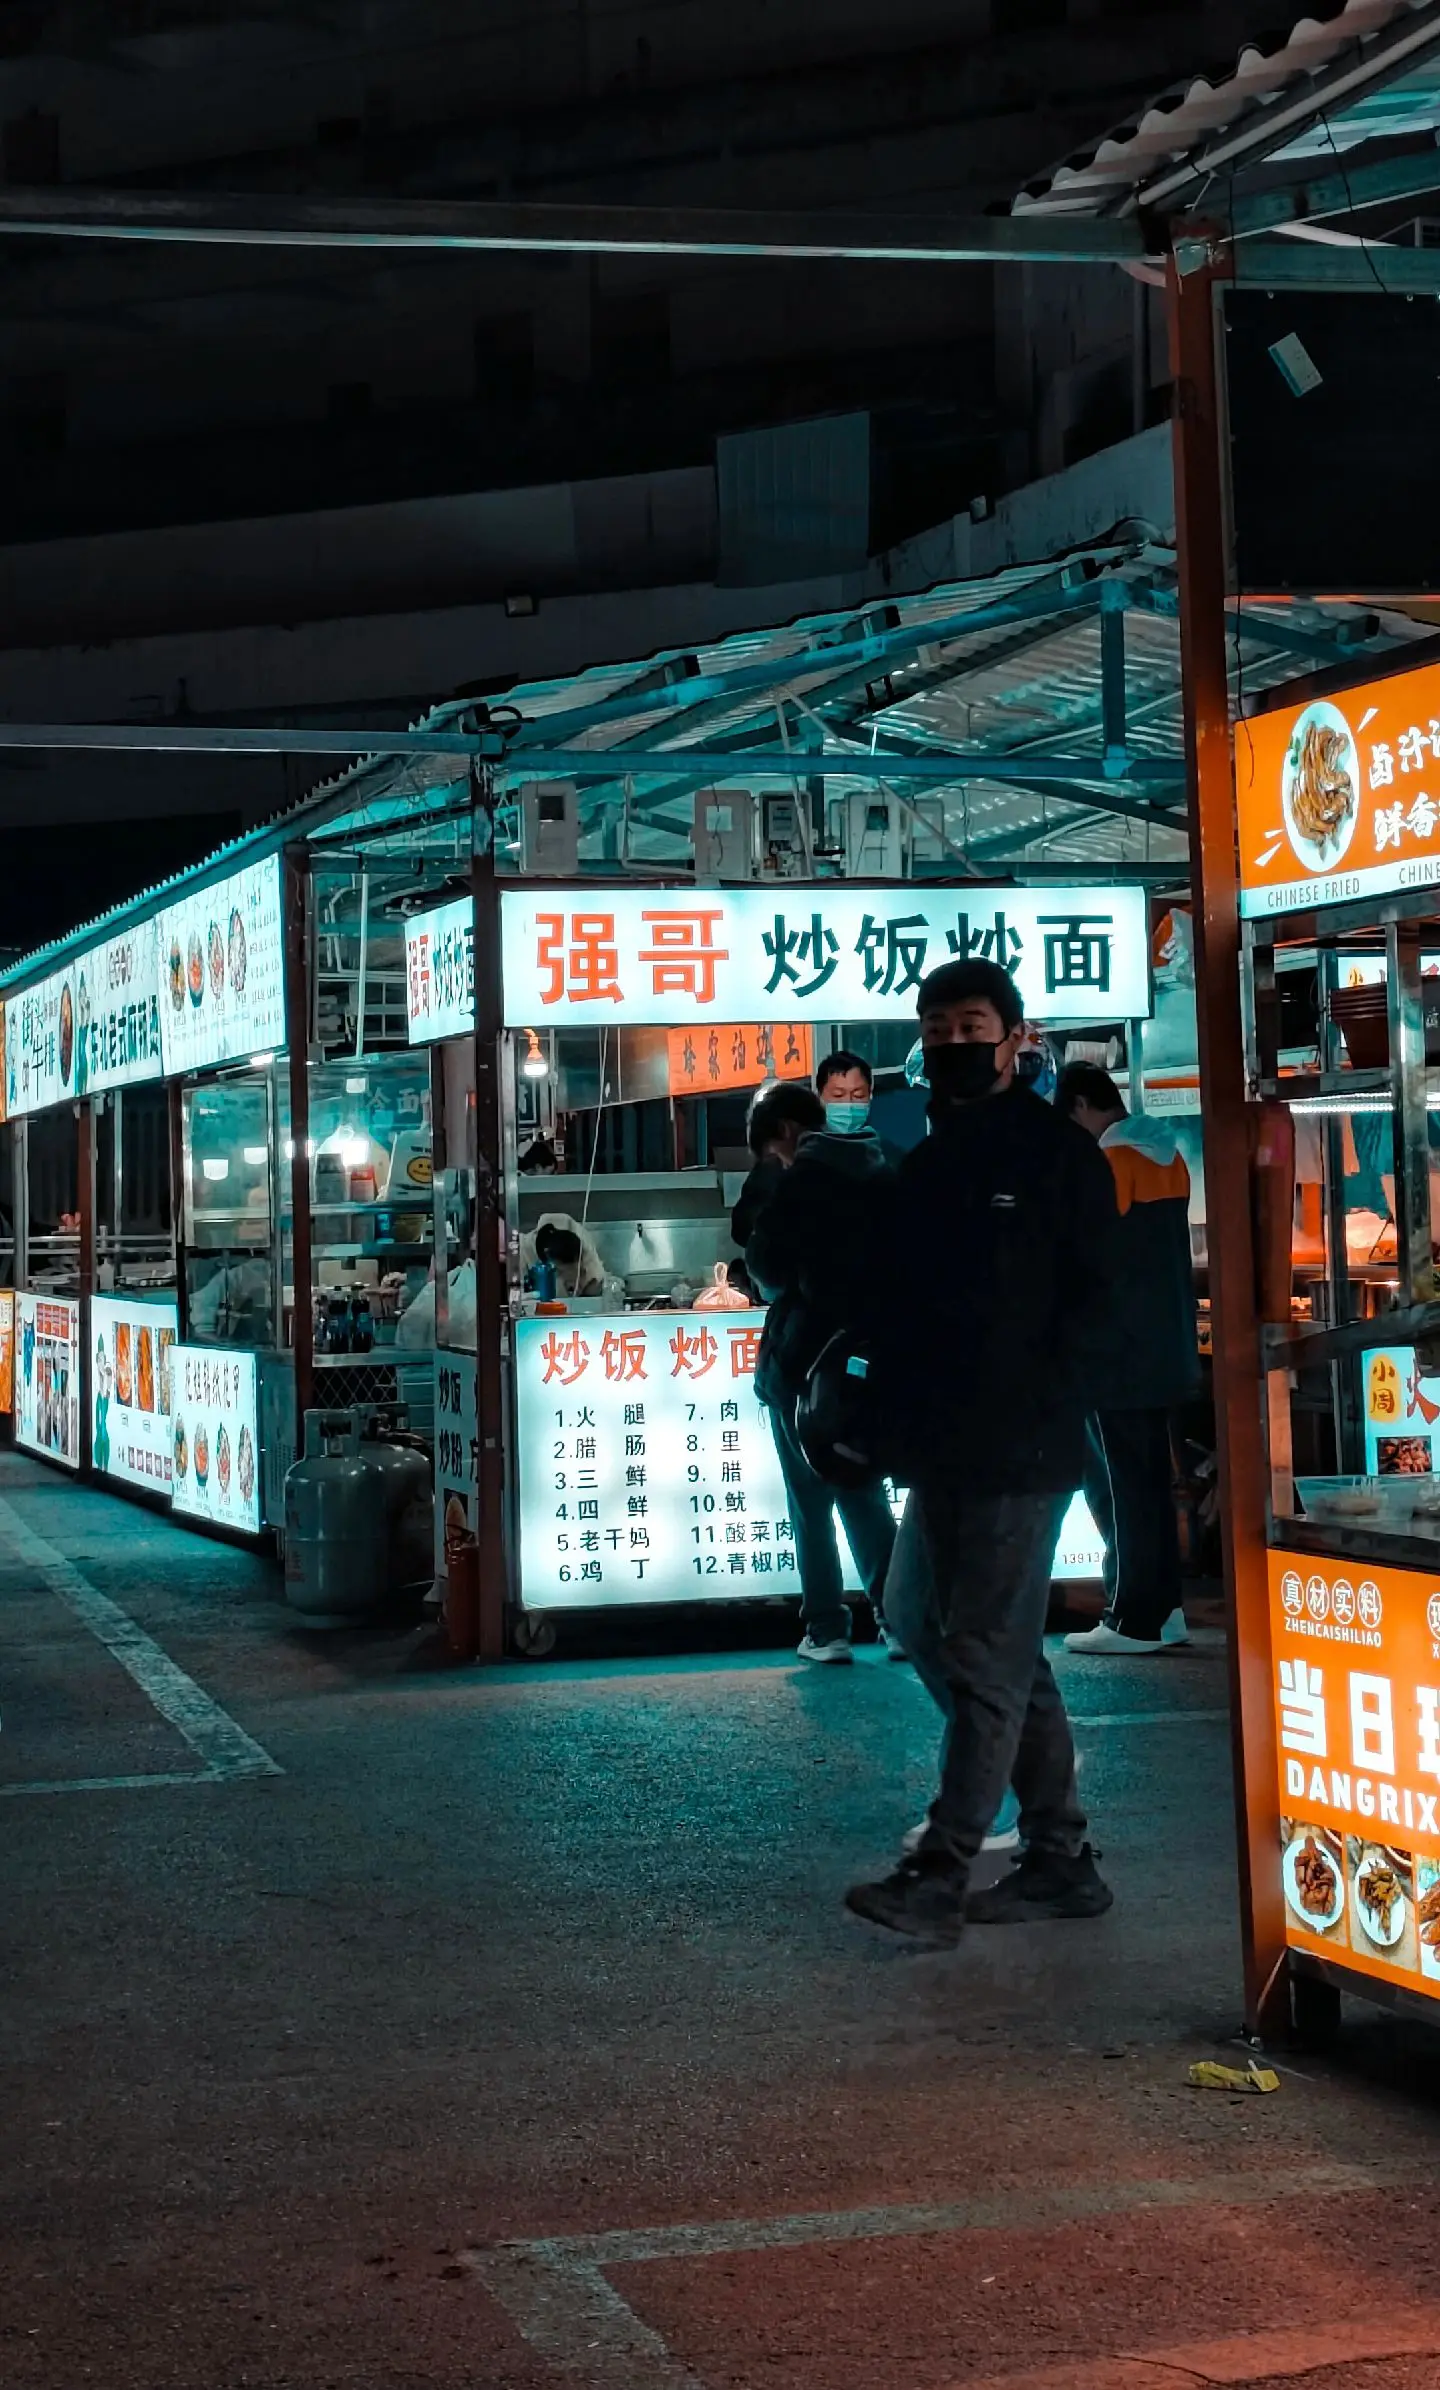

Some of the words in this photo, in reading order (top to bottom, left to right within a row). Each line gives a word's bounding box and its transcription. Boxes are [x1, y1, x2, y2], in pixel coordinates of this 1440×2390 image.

[1375, 792, 1440, 852] 鲜香
[1268, 885, 1319, 908] CHINESE
[1325, 878, 1360, 900] FRIED
[409, 934, 429, 1020] 强哥
[536, 910, 729, 1004] 强哥
[761, 911, 1113, 998] 炒饭炒面
[439, 1366, 462, 1416] 炒饭
[1370, 1361, 1395, 1414] 小周
[557, 1527, 650, 1552] 5.老干妈
[691, 1519, 794, 1544] 11.酸菜肉
[692, 1549, 795, 1575] 12.青椒肉
[1284, 1576, 1379, 1622] 真材实料
[1284, 1616, 1382, 1649] ZHENCAISHILIAO
[1286, 1758, 1440, 1835] DANGRIX
